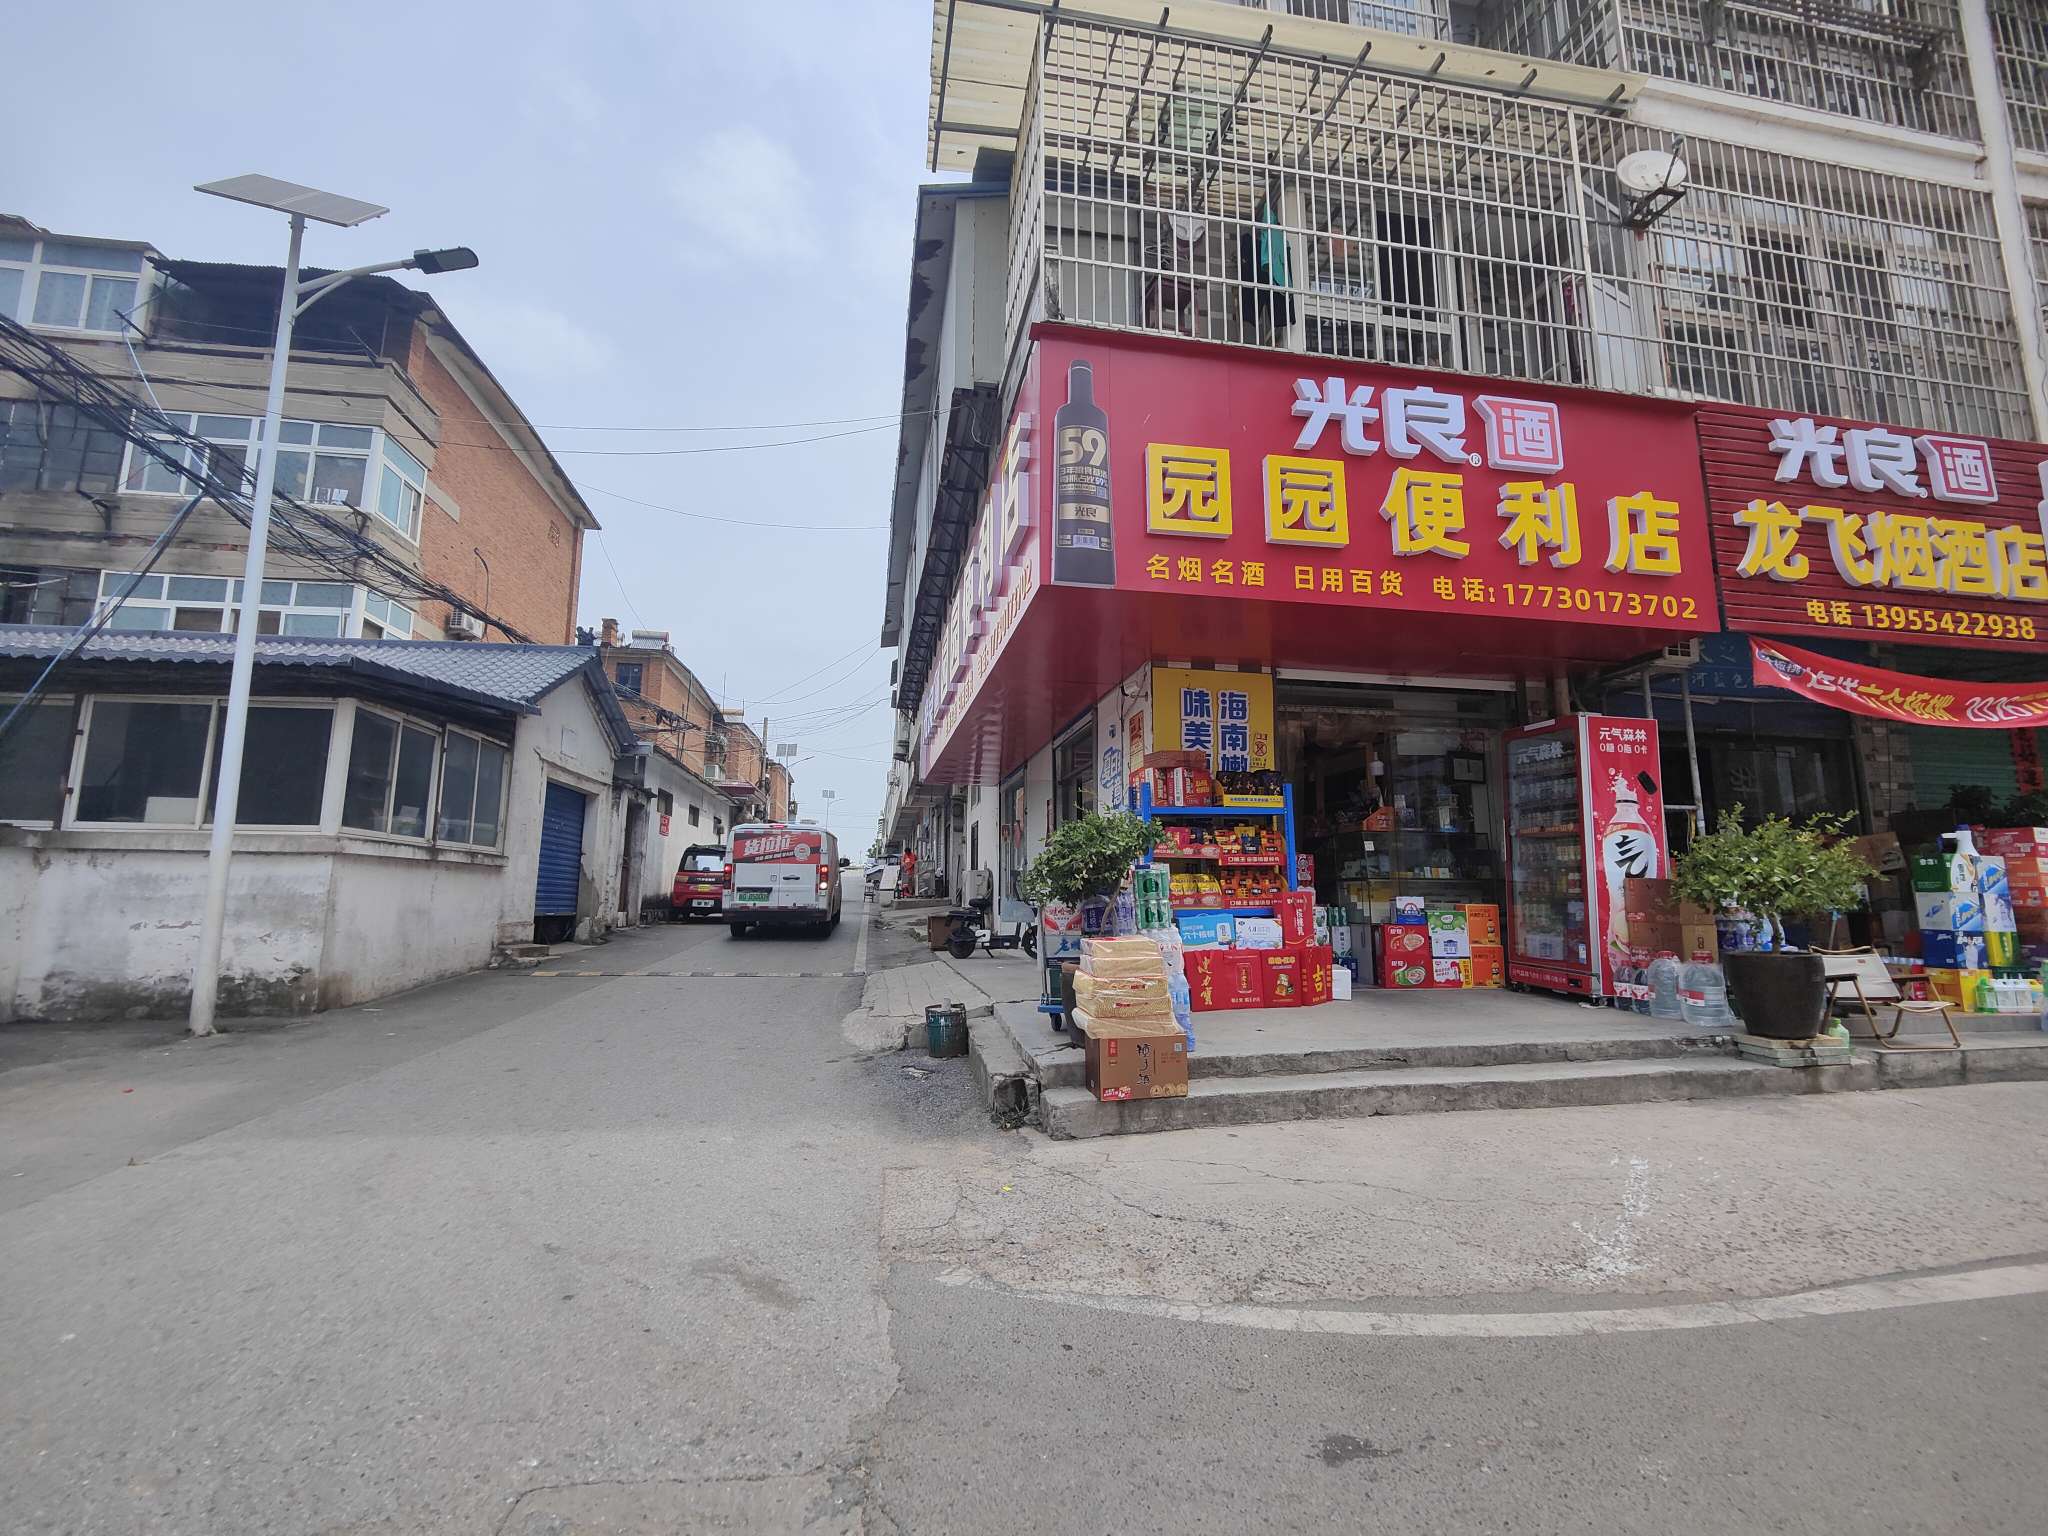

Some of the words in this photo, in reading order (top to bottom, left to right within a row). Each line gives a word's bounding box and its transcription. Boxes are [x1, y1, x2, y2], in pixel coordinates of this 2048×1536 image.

[1060, 428, 1107, 467] 59
[1145, 442, 1682, 576] 园园便利店
[1733, 498, 2048, 602] 龙飞烟酒店
[1145, 554, 1266, 587] 名烟名酒
[1293, 565, 1405, 597] 日用百货
[1806, 600, 1853, 627] 电话
[1862, 604, 2037, 641] 13955422938
[1517, 741, 1564, 765] 元气森林
[1599, 726, 1647, 743] 元气森林
[743, 834, 791, 857] 货拉拉
